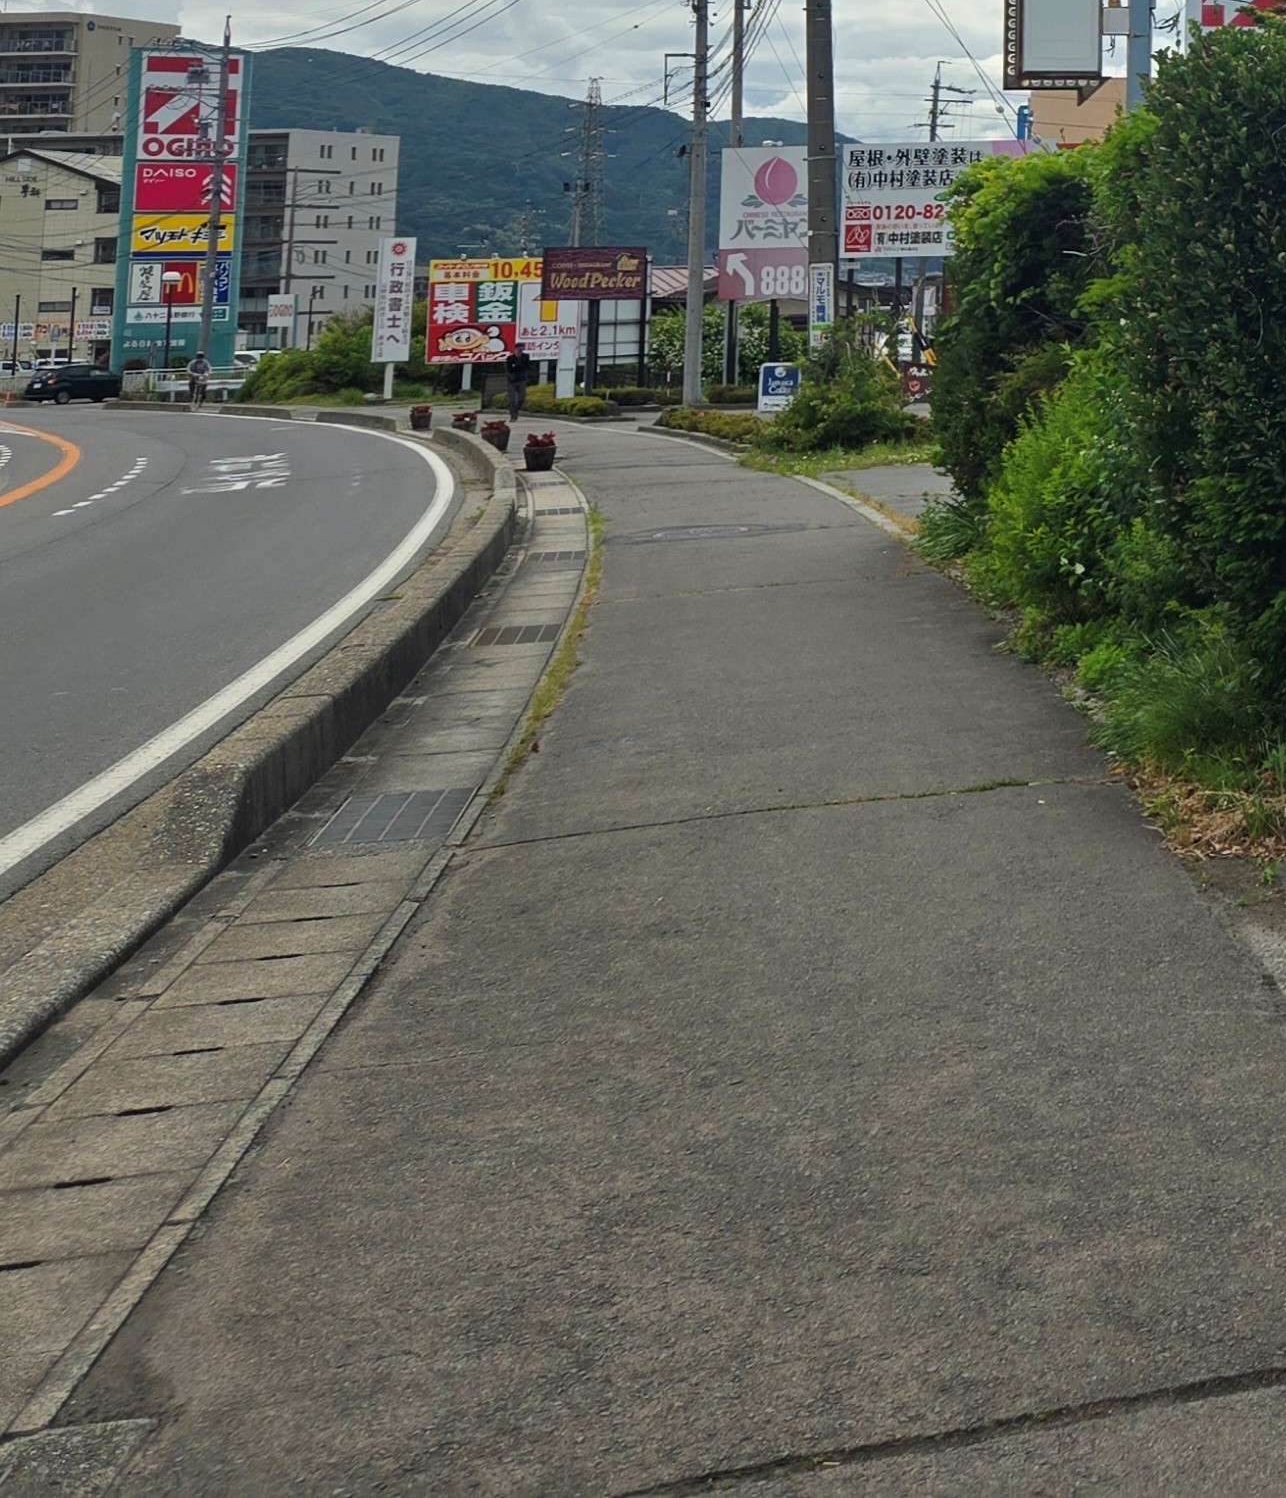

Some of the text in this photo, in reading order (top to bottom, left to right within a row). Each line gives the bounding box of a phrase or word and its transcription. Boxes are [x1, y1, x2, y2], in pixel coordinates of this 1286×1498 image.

[849, 147, 983, 168] 屋根・外壁塗装は
[143, 168, 196, 178] DAISO
[848, 169, 954, 189] (有)中村塗装店
[770, 210, 807, 218] RESTAURAN
[872, 204, 949, 220] 0120-82-
[444, 271, 480, 279] 基本料金
[490, 262, 543, 279] 10,45
[761, 265, 808, 295] 888
[386, 262, 405, 344] 行政書士へ
[433, 282, 470, 324] 車検
[145, 311, 196, 319] 八十二野銀行
